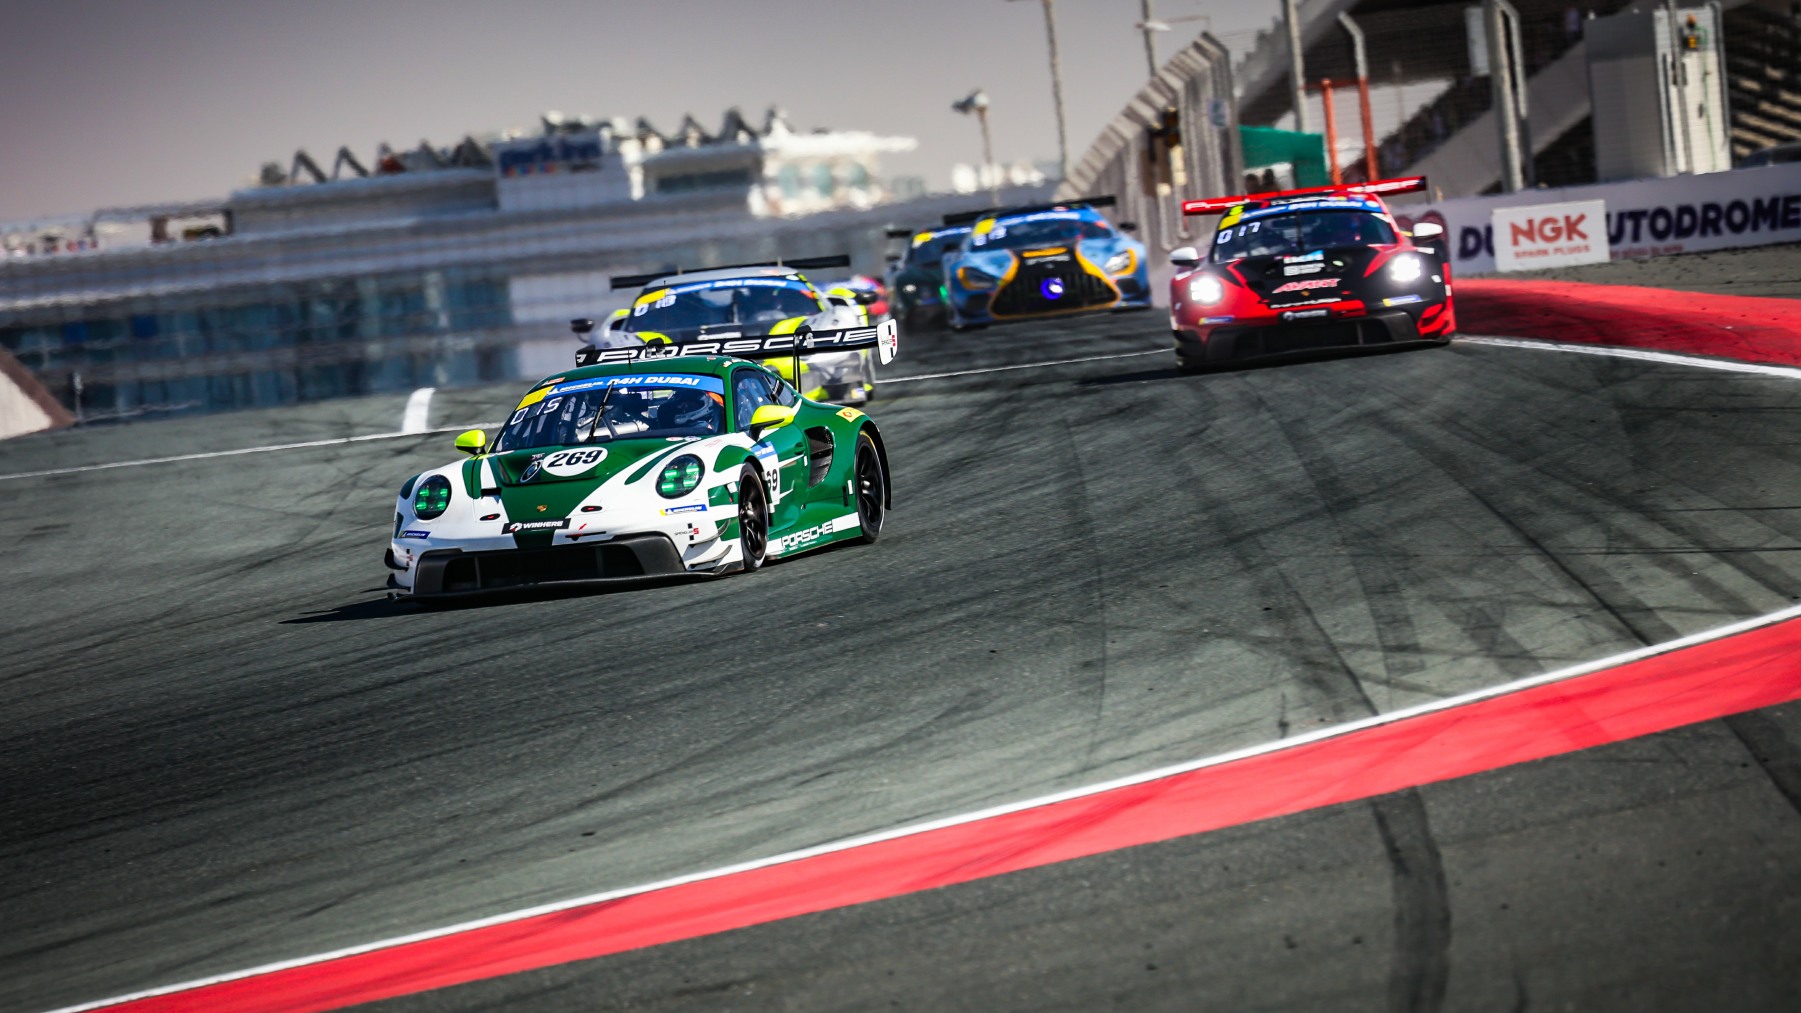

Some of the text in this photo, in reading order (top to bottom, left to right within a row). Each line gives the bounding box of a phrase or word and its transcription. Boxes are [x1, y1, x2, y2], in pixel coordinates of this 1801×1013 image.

[1510, 213, 1588, 246] NGK
[1605, 194, 1801, 246] UTODROME
[1554, 245, 1591, 256] PLUGS
[1272, 278, 1342, 294] AVANT
[597, 327, 878, 362] PORSCHE
[645, 376, 700, 386] DUBAI
[547, 449, 604, 468] 269
[766, 468, 778, 491] 69
[523, 519, 564, 530] WINHERE
[781, 520, 834, 549] PORSCHE
